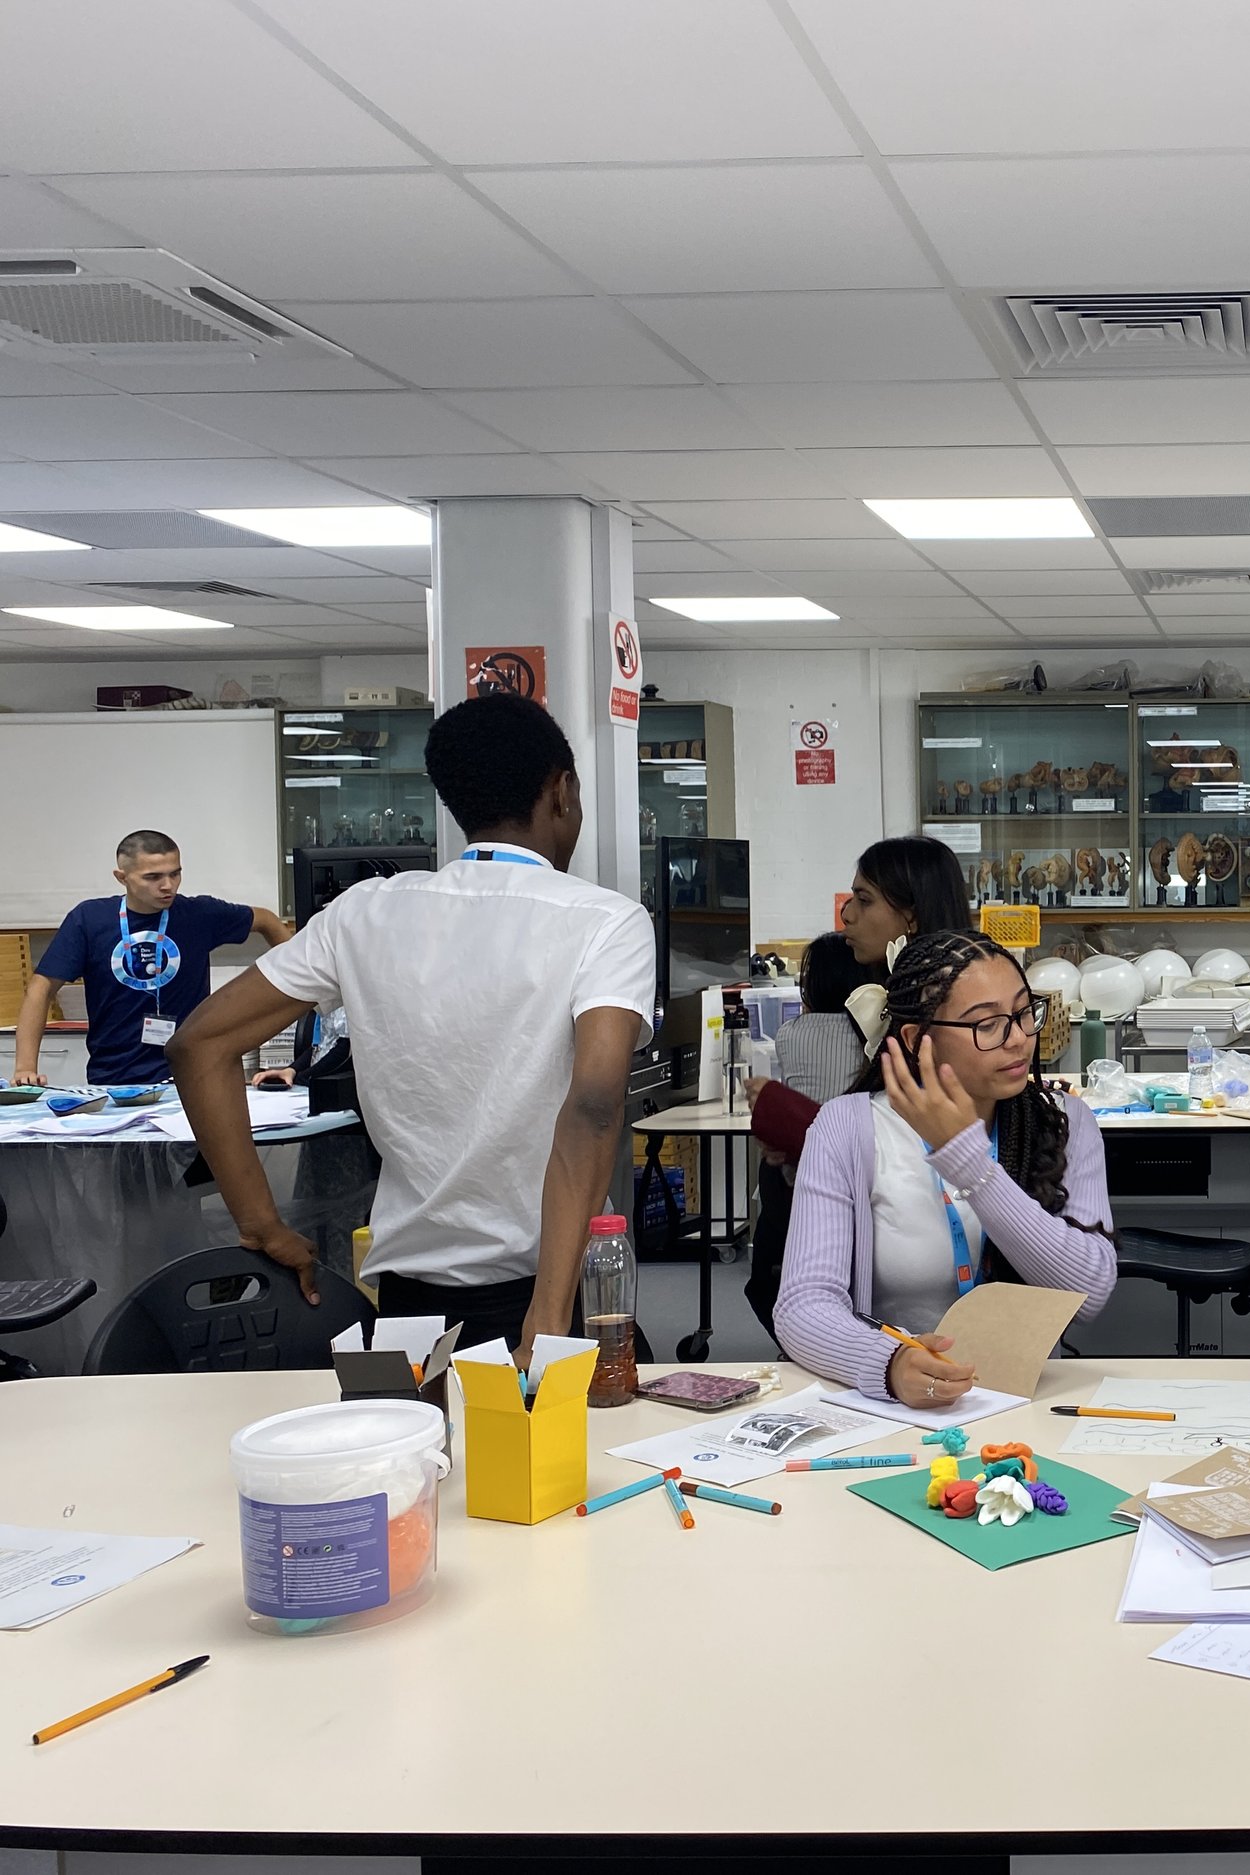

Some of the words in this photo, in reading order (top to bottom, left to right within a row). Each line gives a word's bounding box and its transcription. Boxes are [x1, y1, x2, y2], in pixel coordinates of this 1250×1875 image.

[613, 689, 620, 701] No
[620, 691, 631, 704] food
[631, 696, 637, 705] or
[612, 701, 624, 715] drink
